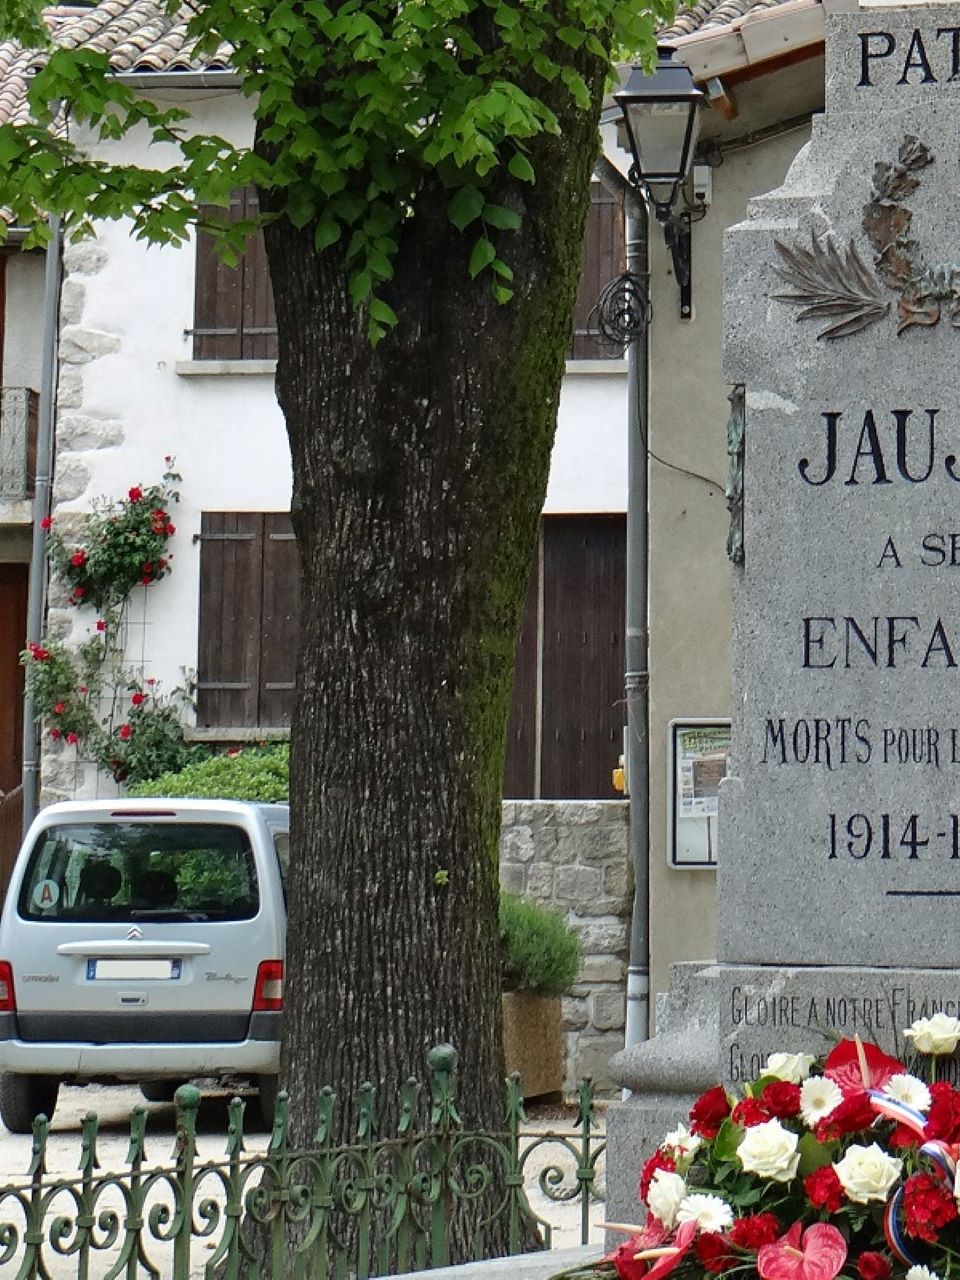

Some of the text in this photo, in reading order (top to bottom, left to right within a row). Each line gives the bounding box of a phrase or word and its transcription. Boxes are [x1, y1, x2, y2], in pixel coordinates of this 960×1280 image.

[876, 536, 902, 568] A
[760, 718, 873, 770] MORTS
[883, 728, 942, 770] POUR
[40, 883, 53, 903] A
[731, 986, 801, 1028] GLOIRE
[807, 997, 819, 1027] A
[826, 997, 885, 1029] NOTRE
